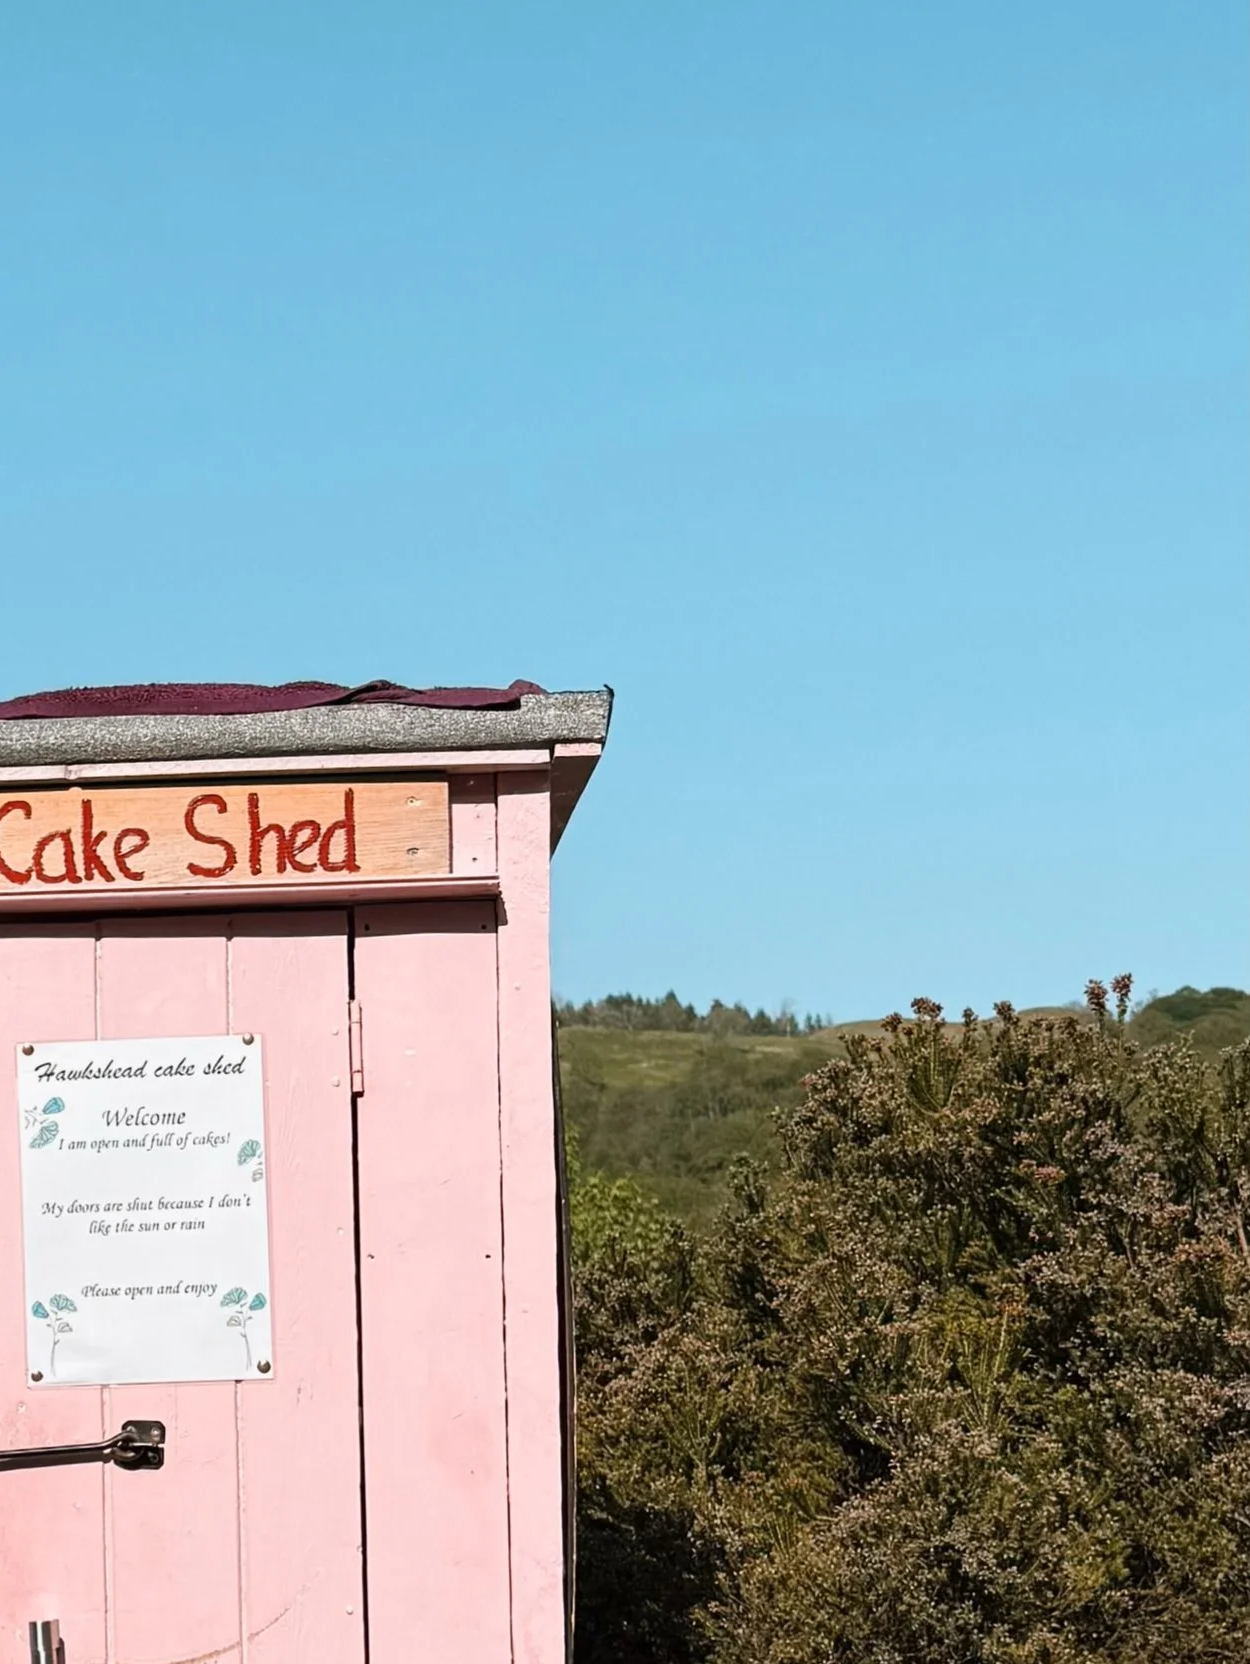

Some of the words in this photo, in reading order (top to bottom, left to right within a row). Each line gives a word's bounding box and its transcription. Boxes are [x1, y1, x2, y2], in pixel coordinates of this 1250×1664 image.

[185, 787, 360, 876] Shed
[34, 1060, 148, 1082] Hawkshead
[154, 1057, 195, 1077] cake
[203, 1055, 246, 1075] shed
[102, 1106, 186, 1127] Welcome
[59, 1138, 64, 1150] I
[68, 1140, 86, 1150] am
[91, 1140, 118, 1153] open
[123, 1134, 146, 1148] and
[146, 1132, 172, 1151] full
[176, 1133, 189, 1150] of
[192, 1132, 230, 1147] cakes!
[41, 1202, 64, 1218] My
[67, 1200, 100, 1214] doors
[104, 1202, 123, 1212] are
[126, 1198, 153, 1211] shut
[158, 1197, 204, 1210] because
[208, 1196, 214, 1208] I
[89, 1220, 111, 1236] like
[115, 1219, 134, 1233] the
[138, 1222, 159, 1232] sun
[164, 1221, 177, 1231] or
[180, 1218, 205, 1230] rain
[81, 1284, 120, 1298] Please
[125, 1287, 153, 1300] open
[157, 1281, 183, 1294] and
[185, 1281, 217, 1297] enjoy
